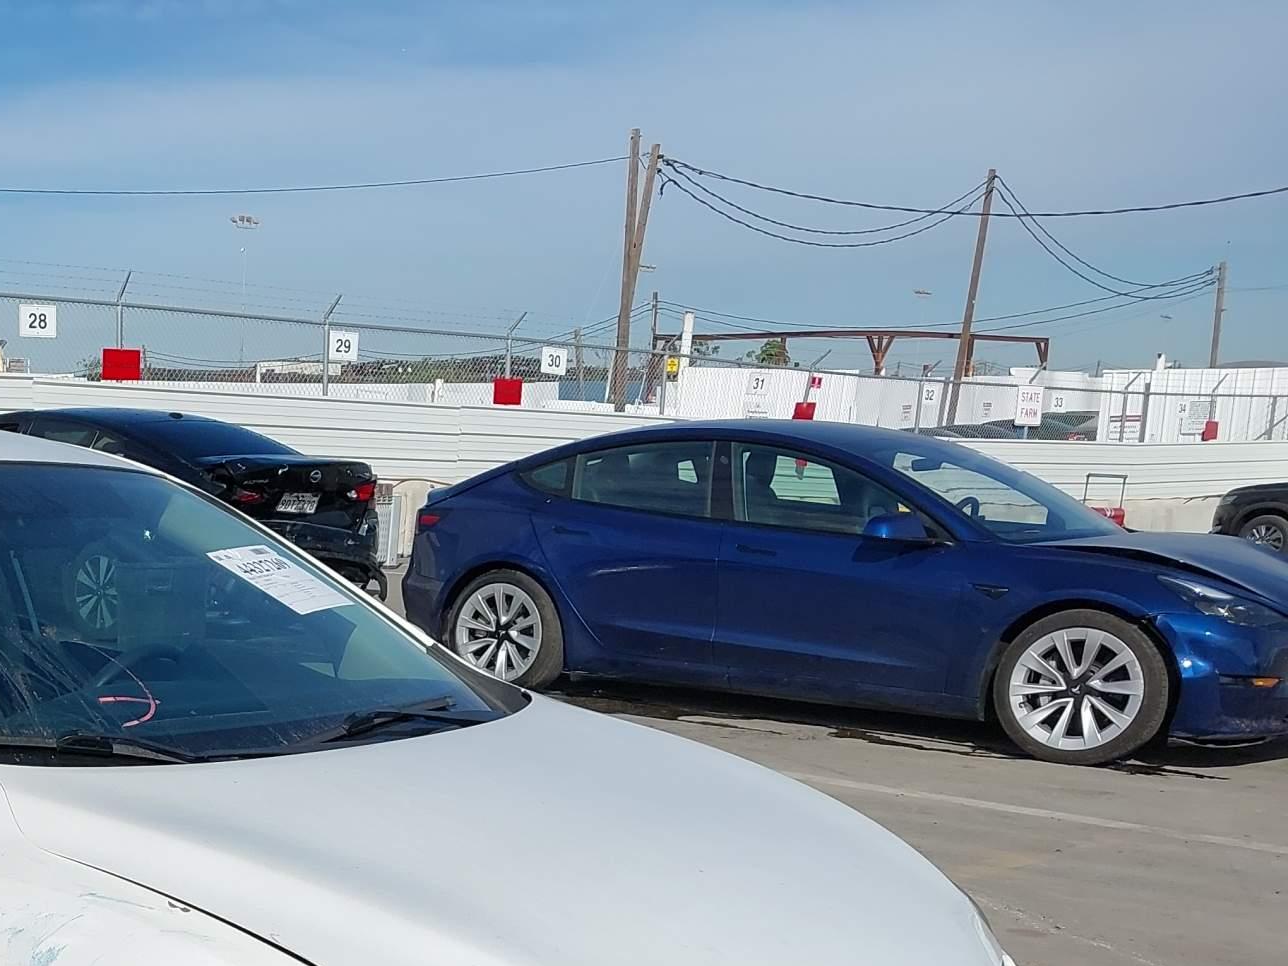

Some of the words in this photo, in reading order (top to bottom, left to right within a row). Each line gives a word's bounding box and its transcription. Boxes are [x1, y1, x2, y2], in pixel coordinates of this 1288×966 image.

[28, 312, 47, 329] 28
[335, 338, 351, 353] 29
[547, 353, 561, 368] 30
[753, 377, 765, 390] 31
[924, 389, 935, 401] 32
[1021, 391, 1041, 403] STATE
[1053, 396, 1064, 408] 33
[1178, 402, 1187, 414] 34
[1021, 407, 1038, 419] FARM
[236, 557, 291, 576] 44327269
